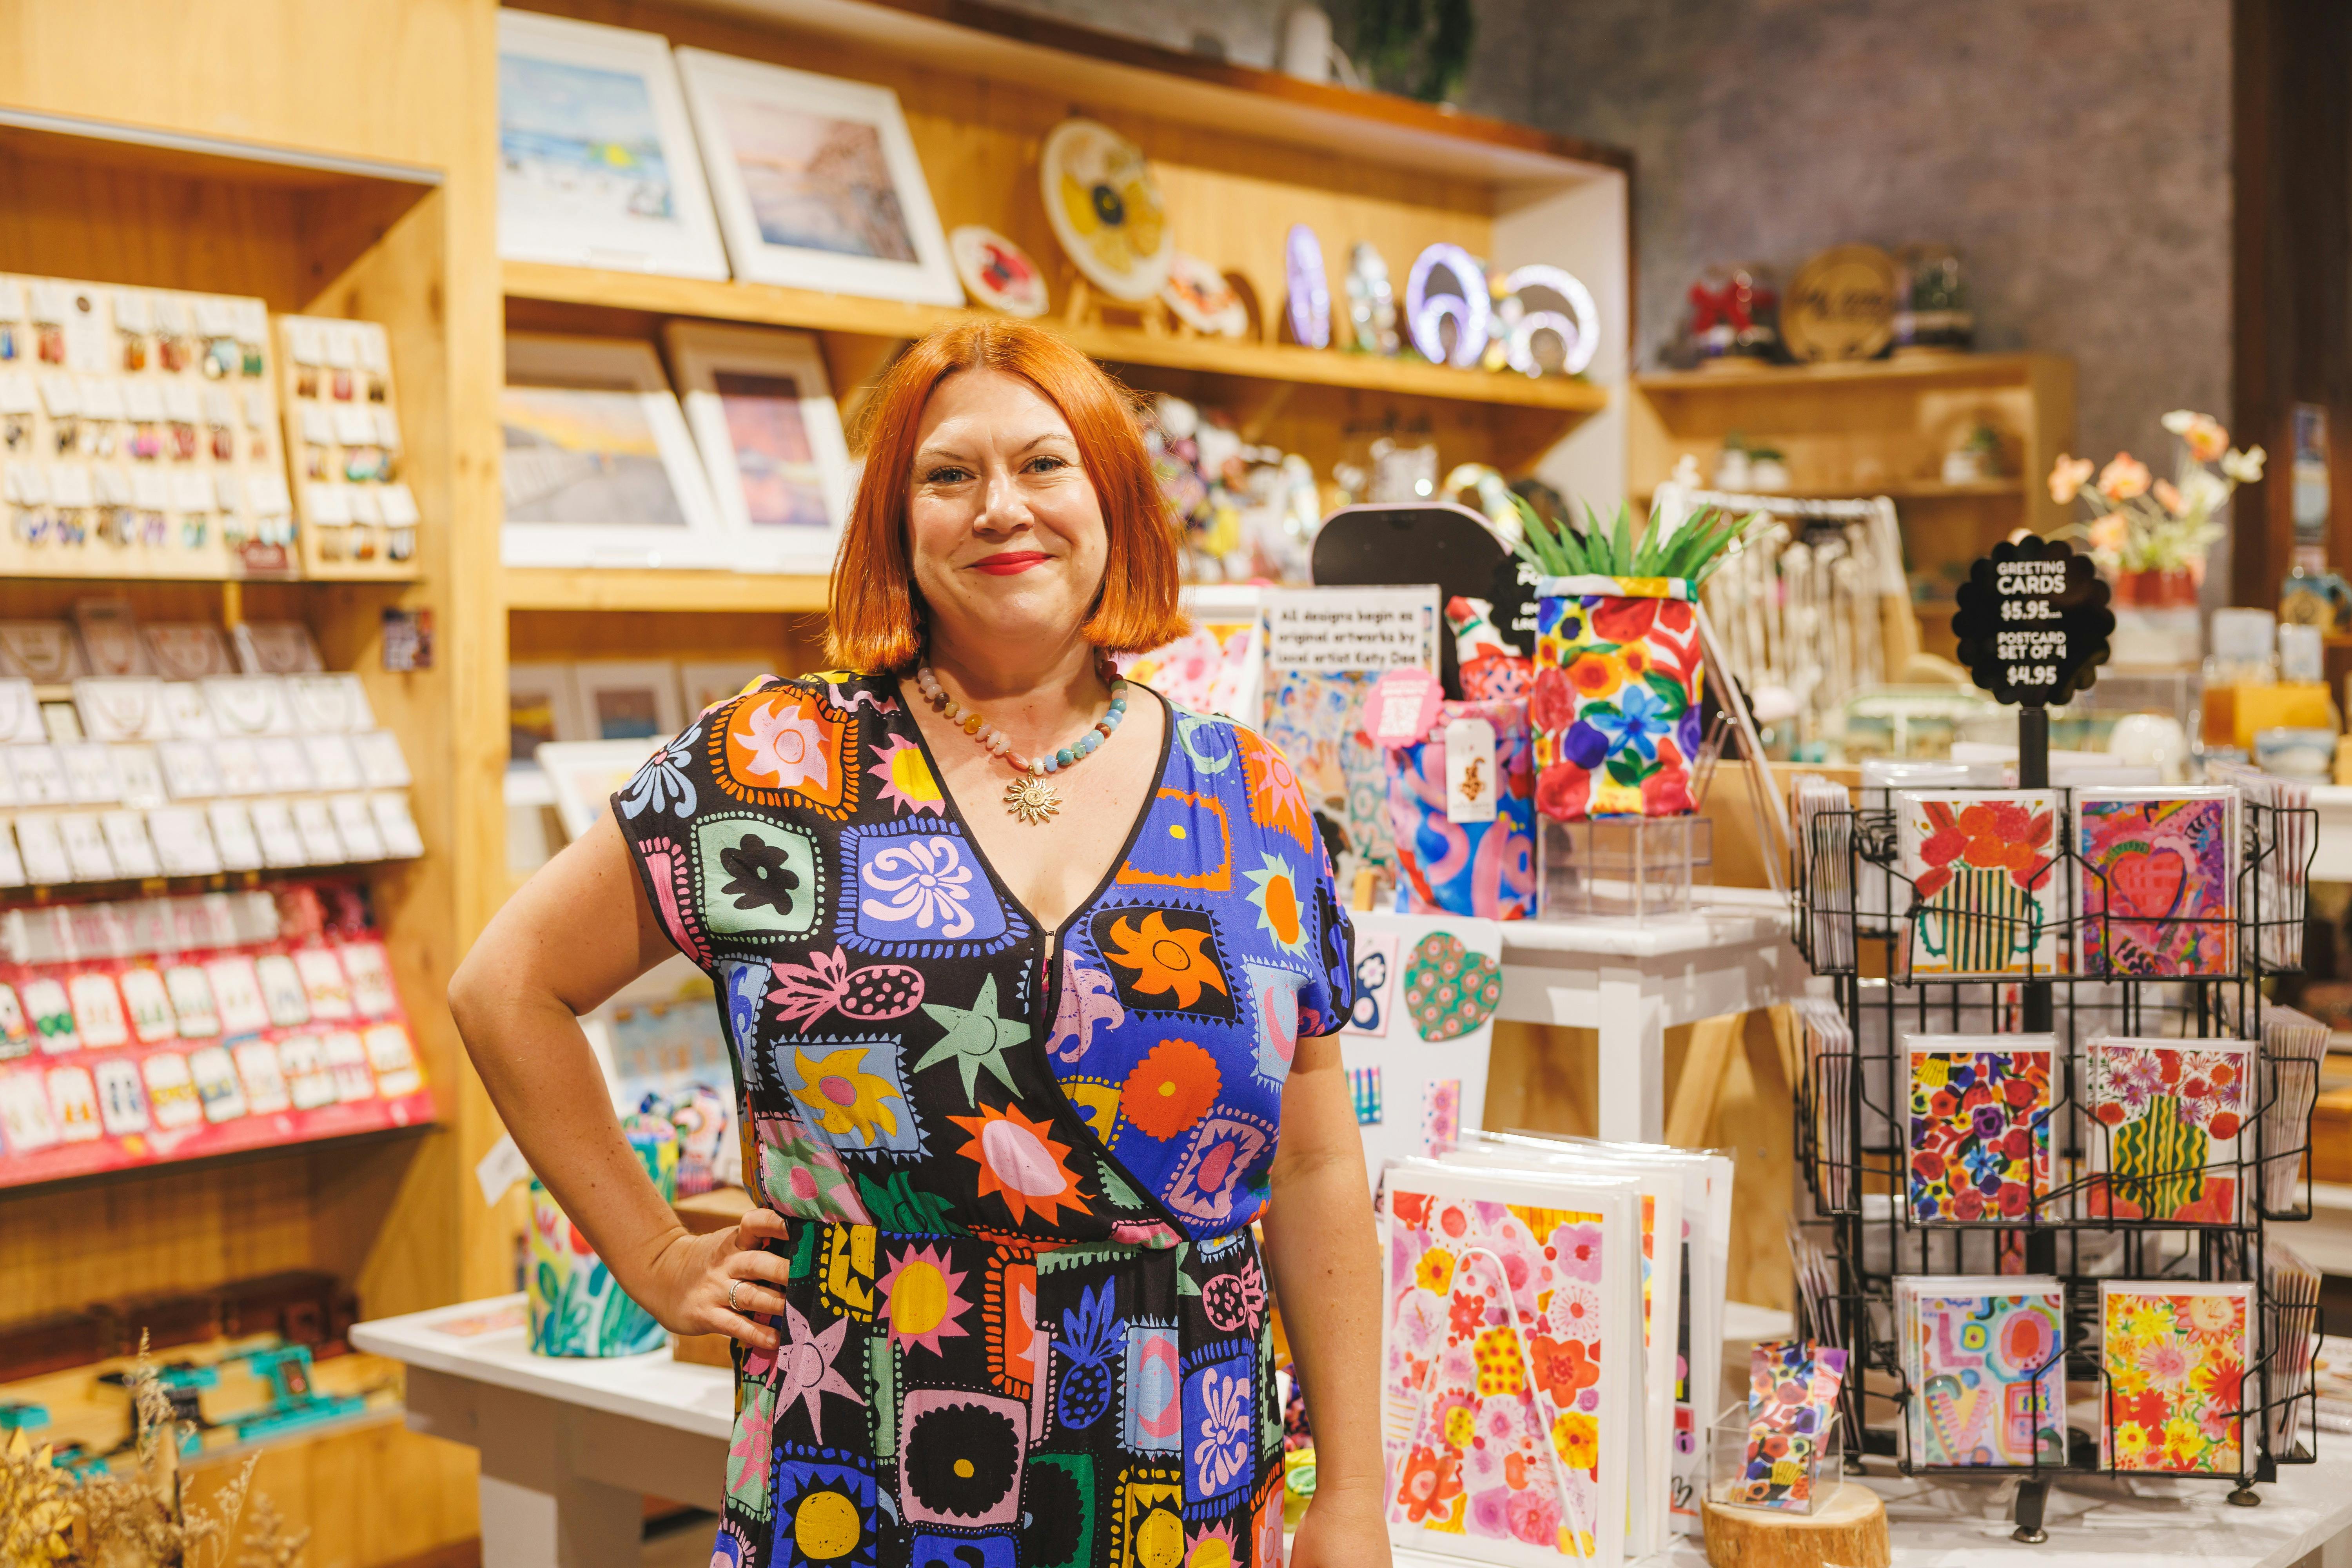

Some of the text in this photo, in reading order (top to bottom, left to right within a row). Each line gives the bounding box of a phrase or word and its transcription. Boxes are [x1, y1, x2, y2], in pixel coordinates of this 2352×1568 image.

[1996, 561, 2066, 575] GREETING
[1996, 575, 2066, 595] CARDS
[1281, 609, 1413, 625] All designs begin as
[2001, 600, 2049, 621] $5.95
[1279, 630, 1415, 645] original artworks by
[1996, 632, 2066, 645] POSTCARD
[1997, 644, 2067, 659] SET OF 4
[1279, 652, 1307, 662] local
[1314, 652, 1350, 662] artist
[1355, 652, 1385, 667] Katy
[2007, 665, 2057, 686] $4.95
